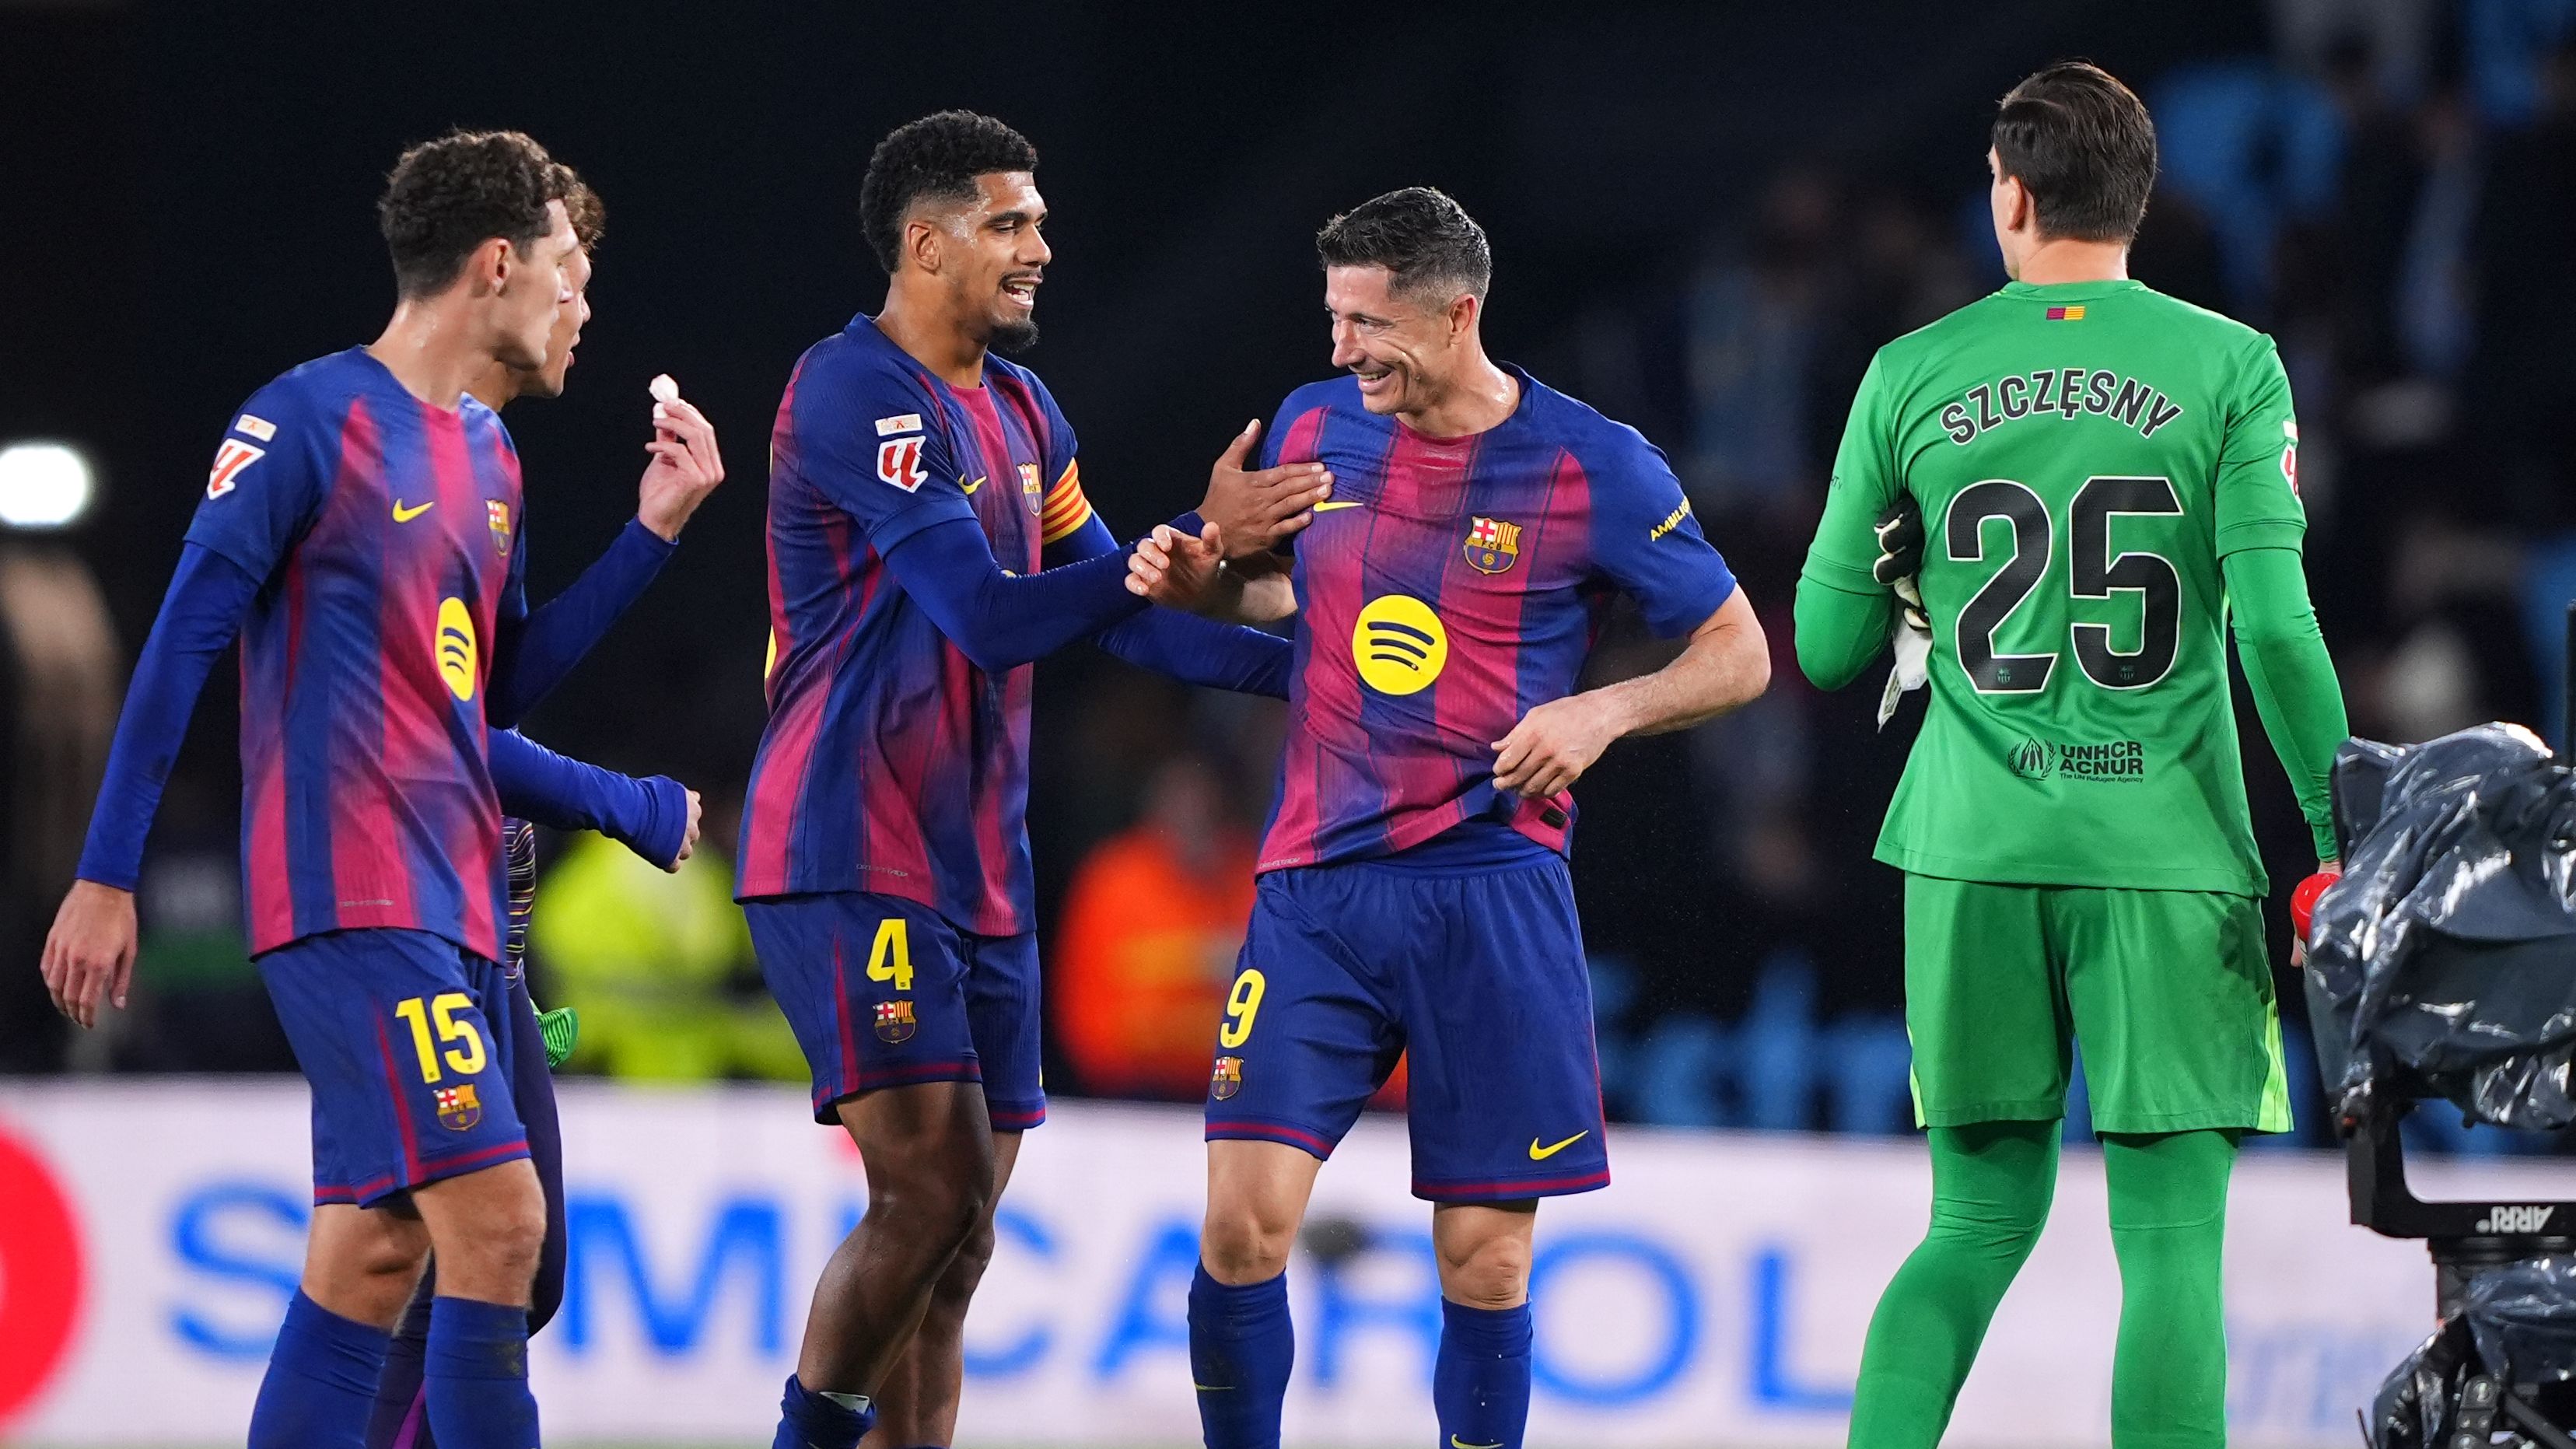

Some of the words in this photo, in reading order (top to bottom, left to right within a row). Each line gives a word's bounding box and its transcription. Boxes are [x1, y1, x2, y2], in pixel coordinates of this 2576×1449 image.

[1940, 367, 2183, 445] SZCZĘSNY
[1945, 476, 2185, 694] 25
[2059, 758, 2144, 775] ACNUR
[2060, 740, 2144, 760] UNHCR
[866, 919, 914, 990] 4
[395, 992, 487, 1084] 15
[1220, 969, 1265, 1048] 9
[2490, 1206, 2555, 1234] ARRI
